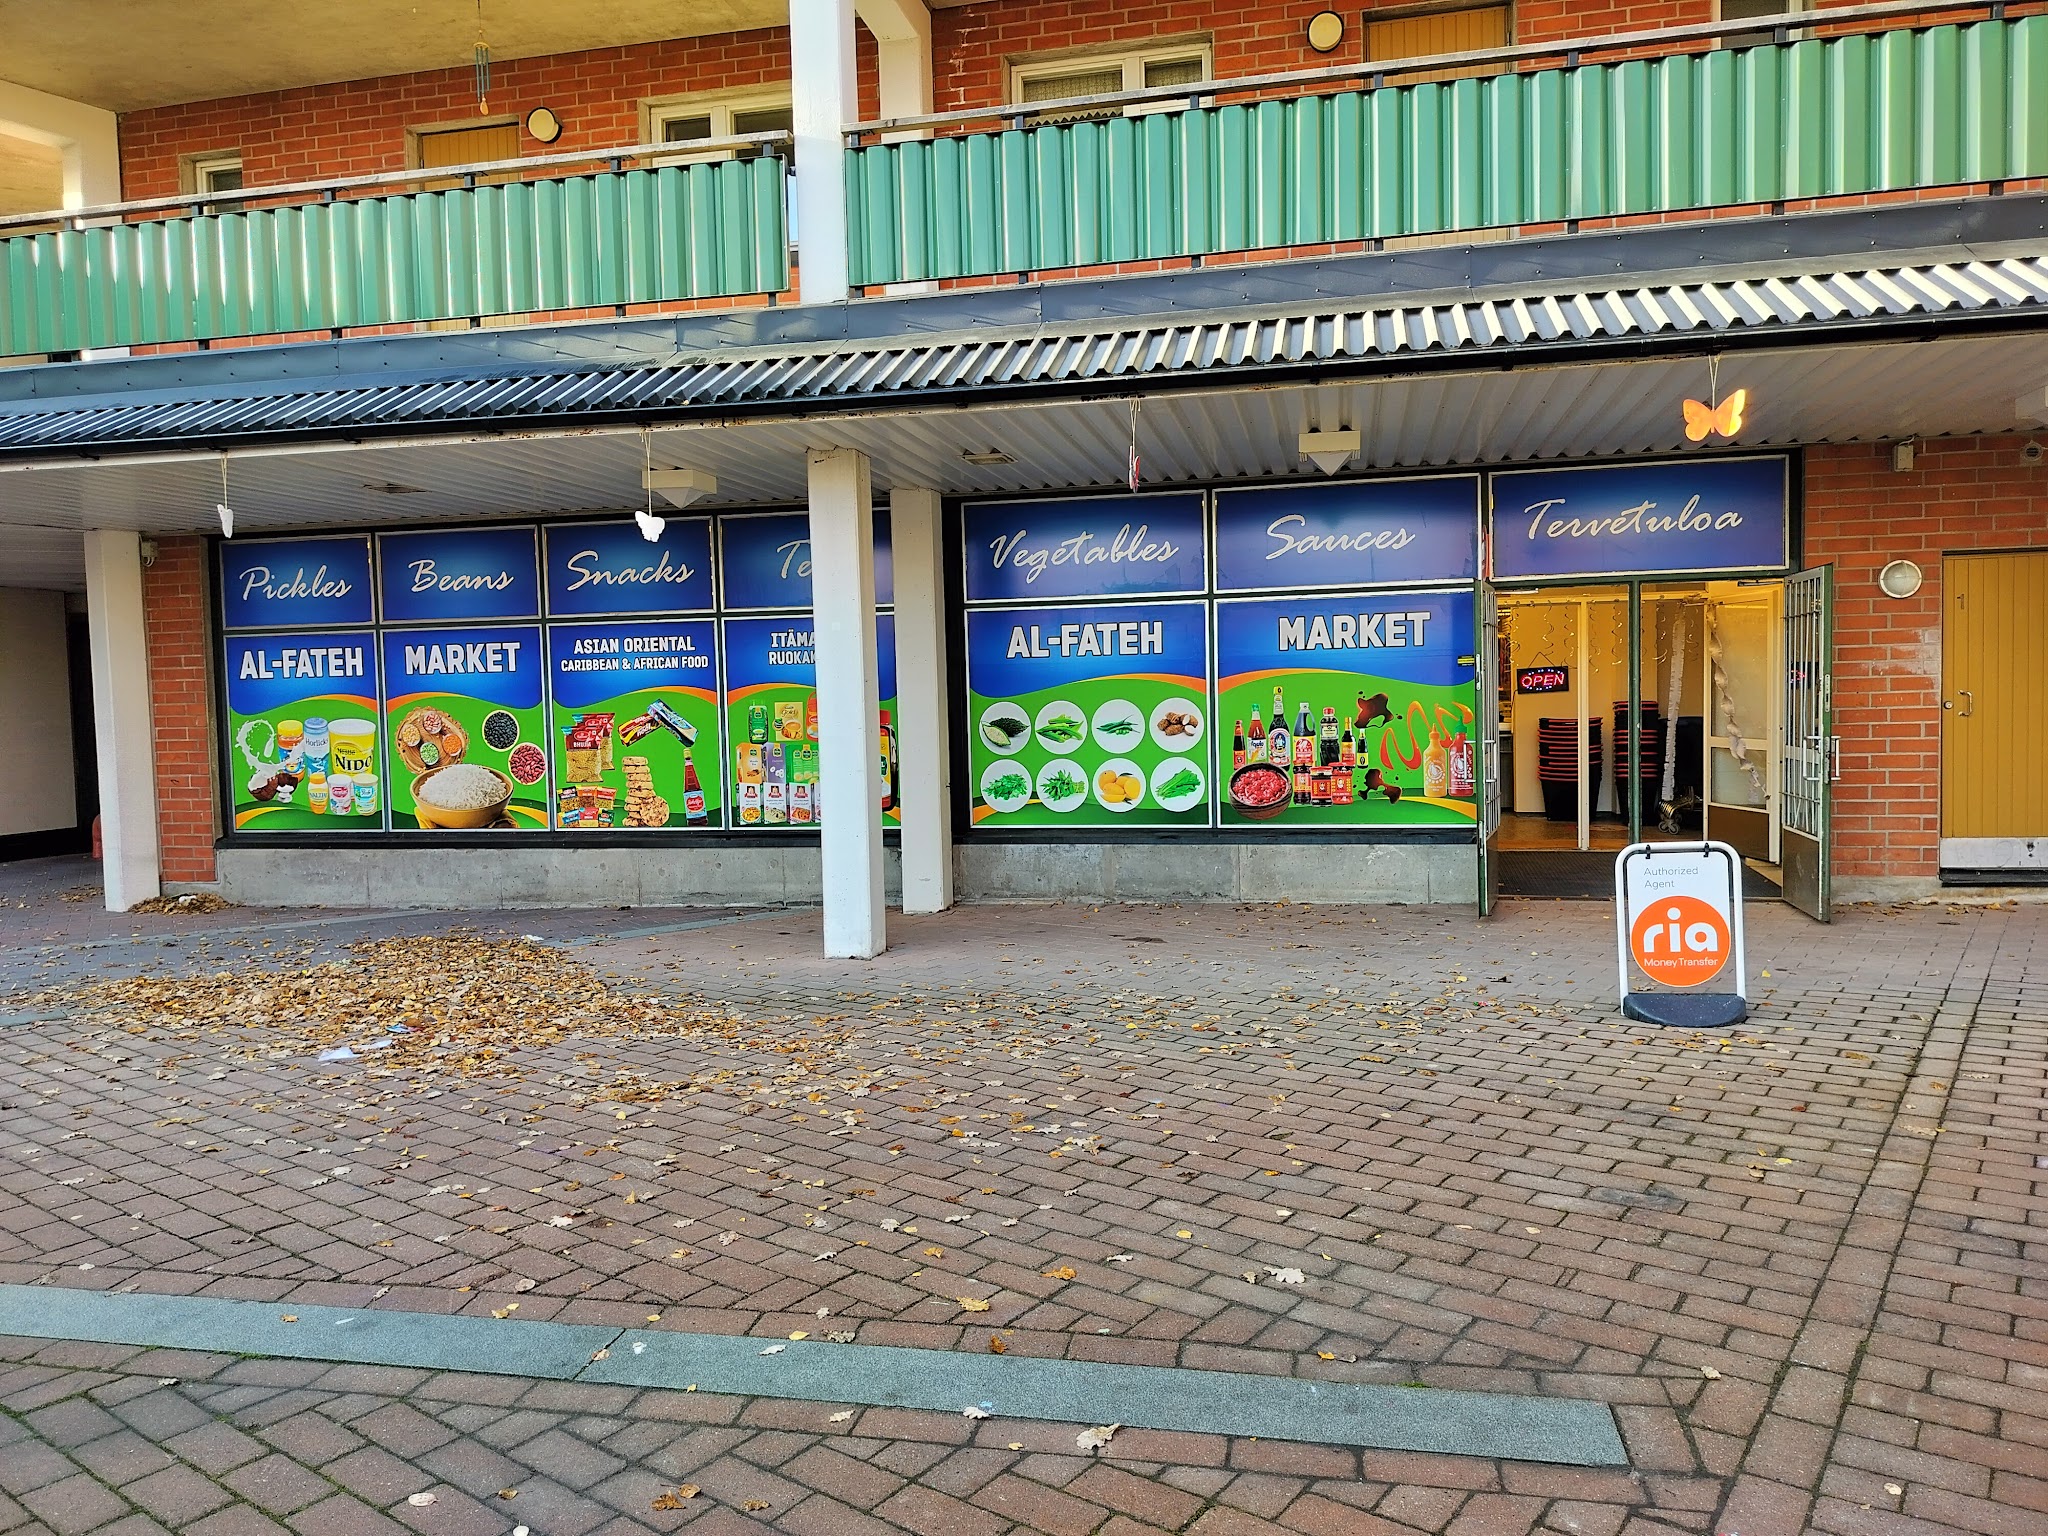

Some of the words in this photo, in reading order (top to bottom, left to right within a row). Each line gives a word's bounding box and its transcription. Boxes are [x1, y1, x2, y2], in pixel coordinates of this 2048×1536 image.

[1524, 494, 1743, 540] Tervetuloa
[989, 523, 1179, 583] Vegetables
[1265, 514, 1416, 560] Sauces
[239, 565, 352, 600] Pickles
[408, 559, 514, 592] Beans
[566, 550, 695, 592] Snacks
[573, 638, 620, 655] ASIAN
[623, 635, 696, 653] ORIENTAL
[1006, 621, 1163, 659] AL-FATEH
[1278, 612, 1431, 651] MARKET
[239, 647, 364, 680] AL-FATEH
[404, 642, 521, 675] MARKET
[560, 659, 619, 672] CARIBBEAN
[621, 658, 632, 670] &
[633, 656, 679, 670] AFRICAN
[681, 655, 709, 669] FOOD
[1521, 674, 1565, 688] OPEN
[1643, 866, 1699, 876] Authorized
[1644, 880, 1675, 890] Agent
[1643, 907, 1718, 953] ria
[1644, 958, 1678, 968] Money
[1678, 957, 1719, 967] Transfer
